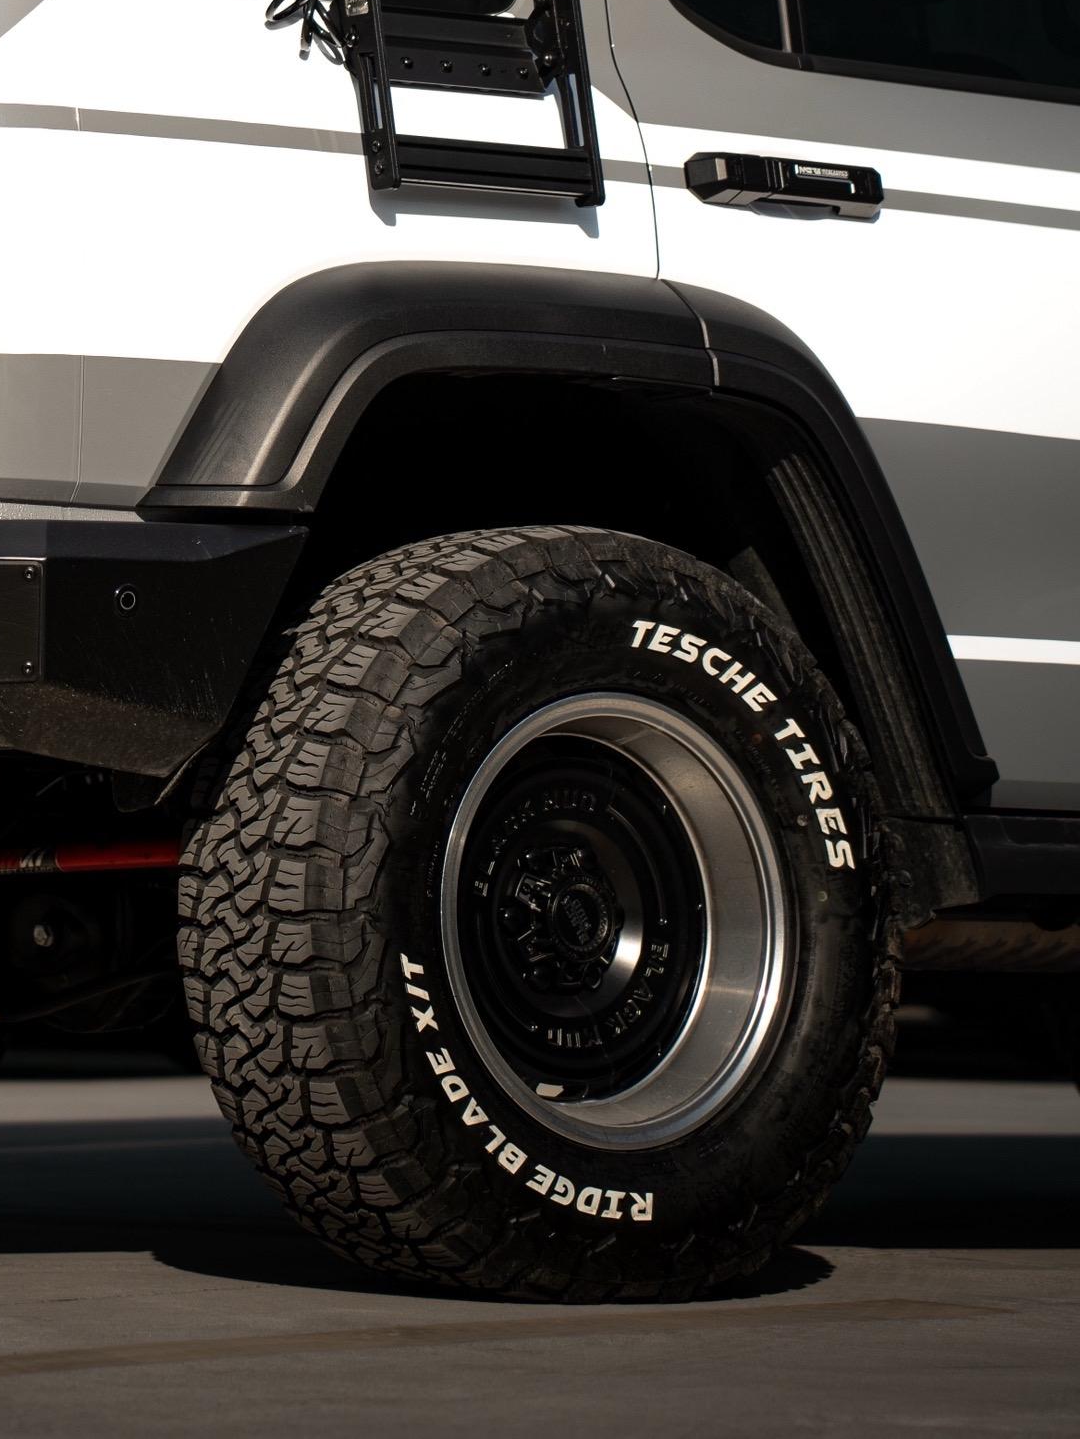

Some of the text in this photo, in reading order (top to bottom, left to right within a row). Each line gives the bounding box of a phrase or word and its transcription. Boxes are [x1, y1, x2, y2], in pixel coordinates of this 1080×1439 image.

[631, 620, 778, 712] TESCHE
[774, 718, 856, 869] TIRES
[426, 1047, 528, 1175] BLADE
[526, 1164, 654, 1221] RIDGE
